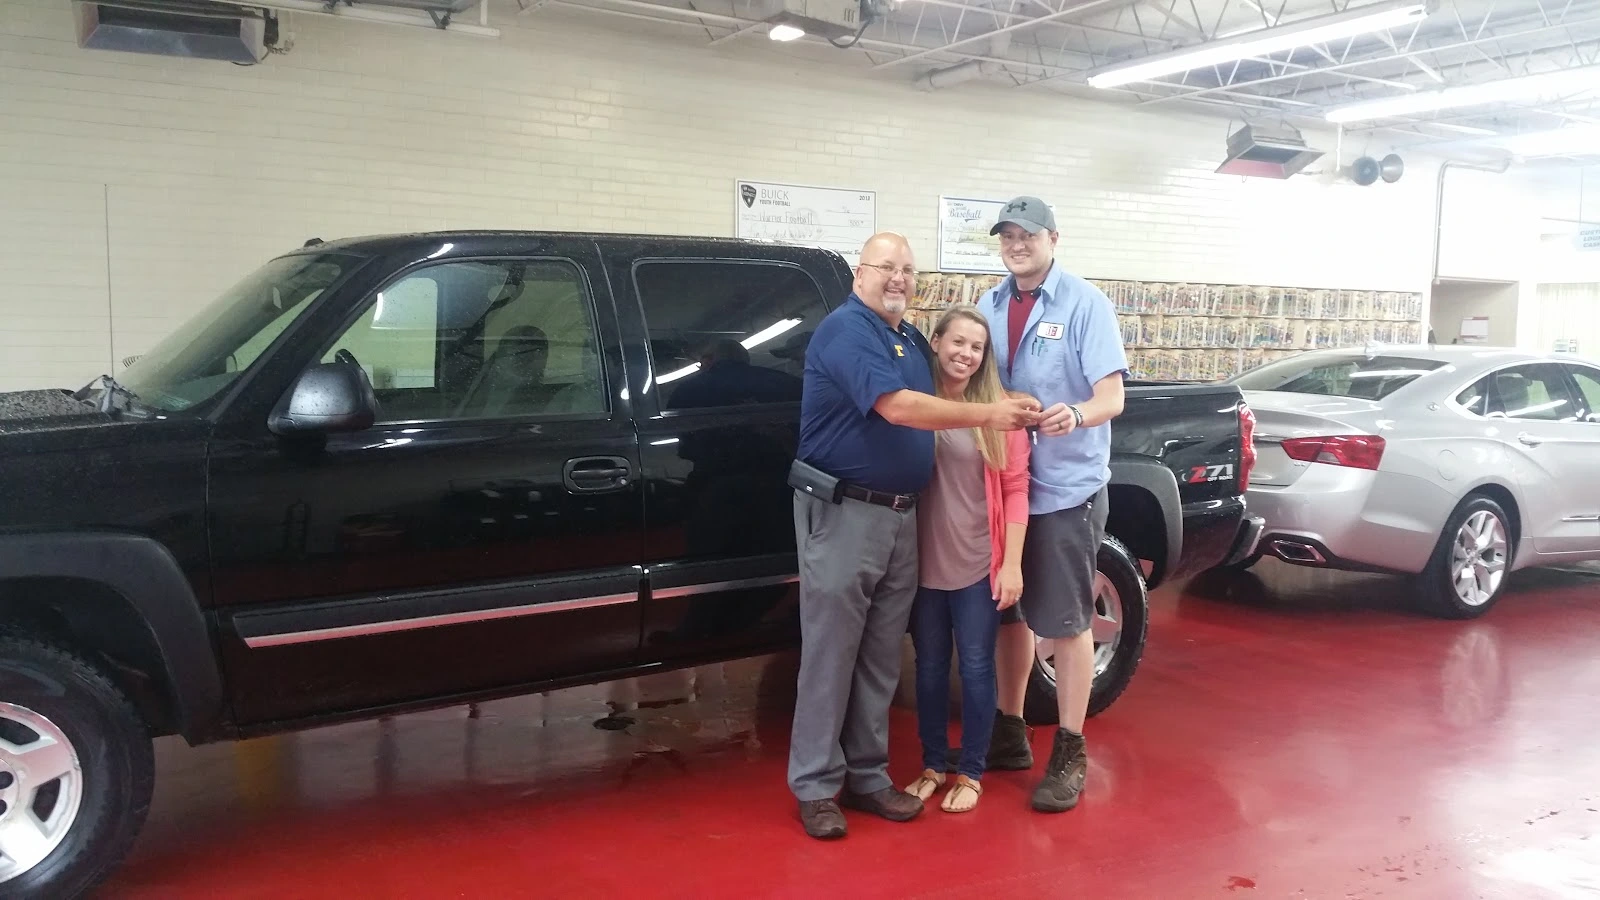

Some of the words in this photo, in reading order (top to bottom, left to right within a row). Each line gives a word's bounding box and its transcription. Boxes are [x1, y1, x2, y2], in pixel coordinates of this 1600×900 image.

[760, 188, 790, 200] BUICK
[785, 211, 813, 225] Football
[948, 208, 982, 219] Baseball
[1188, 463, 1233, 484] Z71
